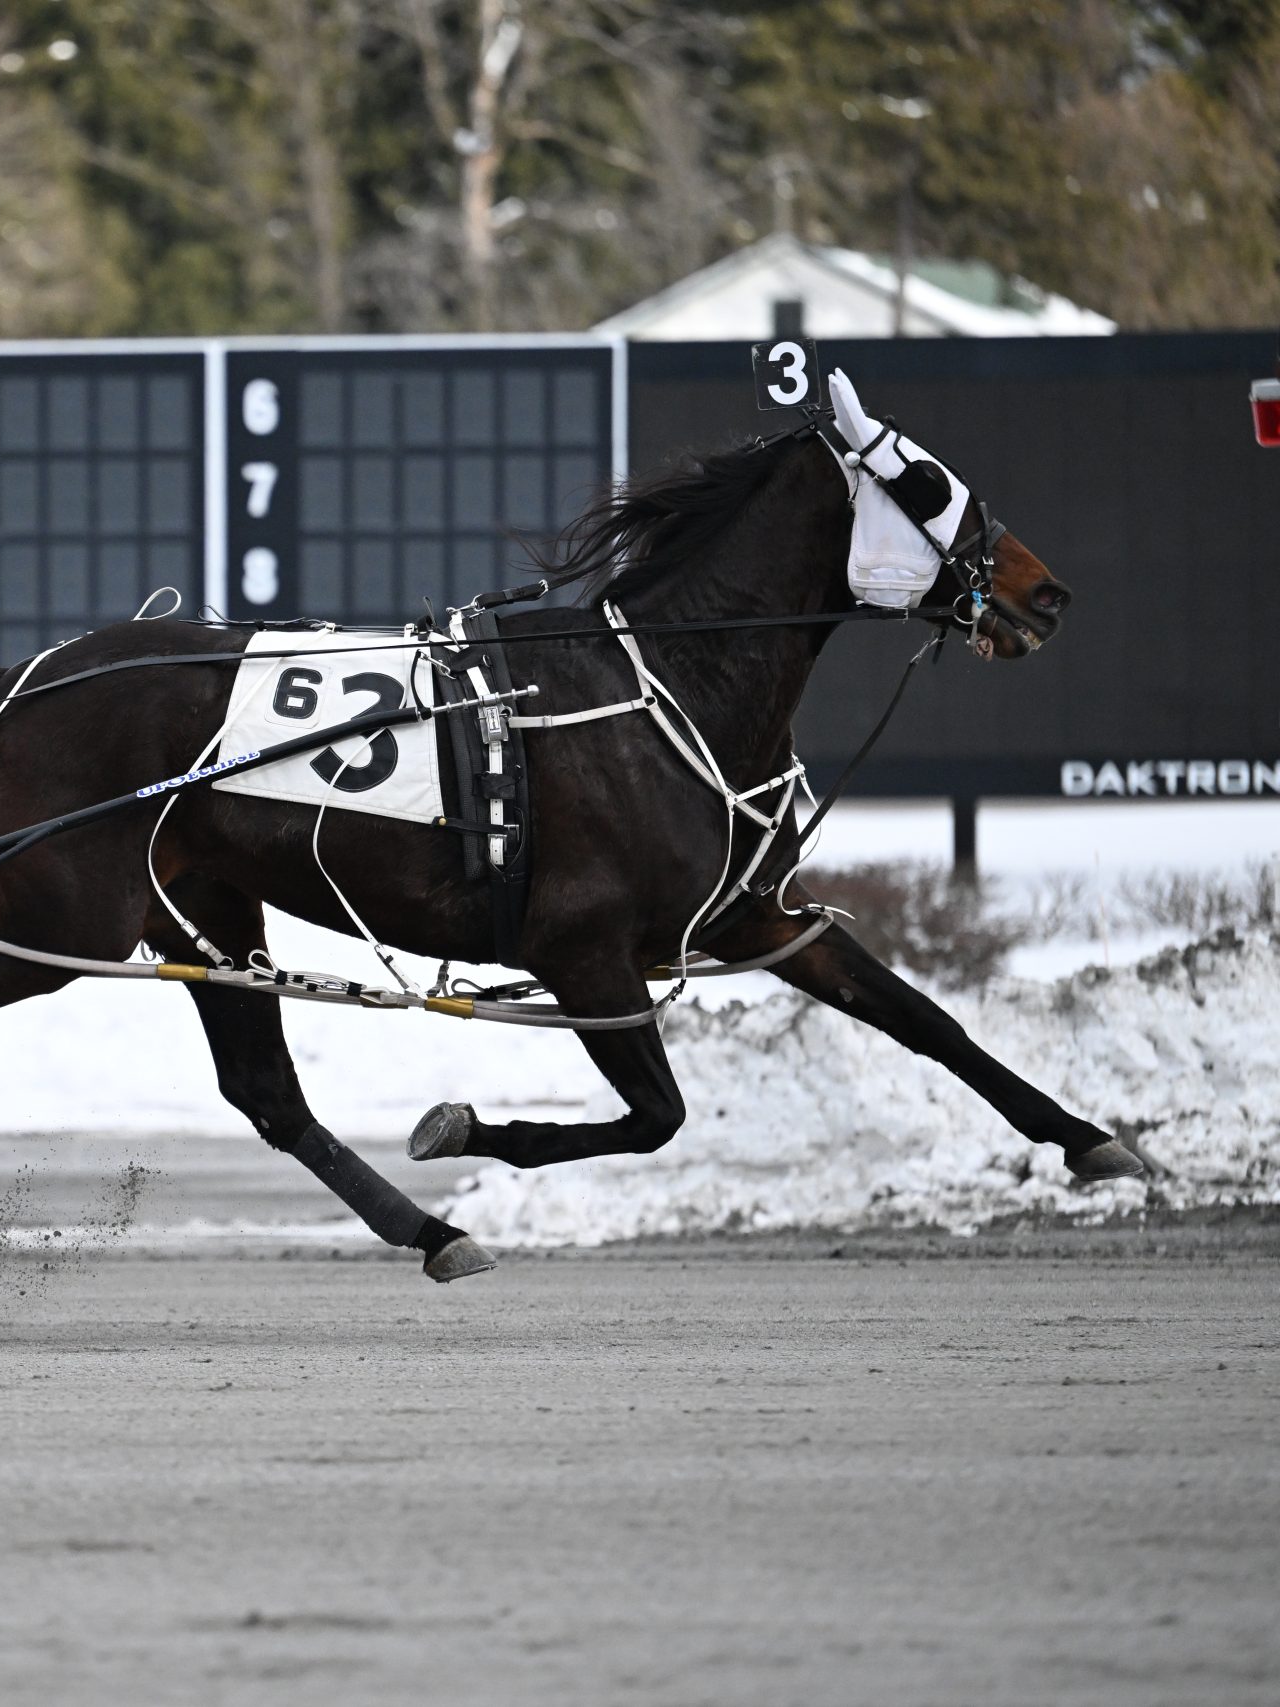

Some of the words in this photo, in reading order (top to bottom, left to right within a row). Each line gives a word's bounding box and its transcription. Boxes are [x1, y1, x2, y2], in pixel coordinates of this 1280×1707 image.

[767, 341, 809, 405] 3
[243, 379, 278, 435] 6
[242, 462, 278, 518] 7
[243, 547, 278, 604] 8
[272, 667, 323, 719] 6
[310, 672, 405, 793] 3
